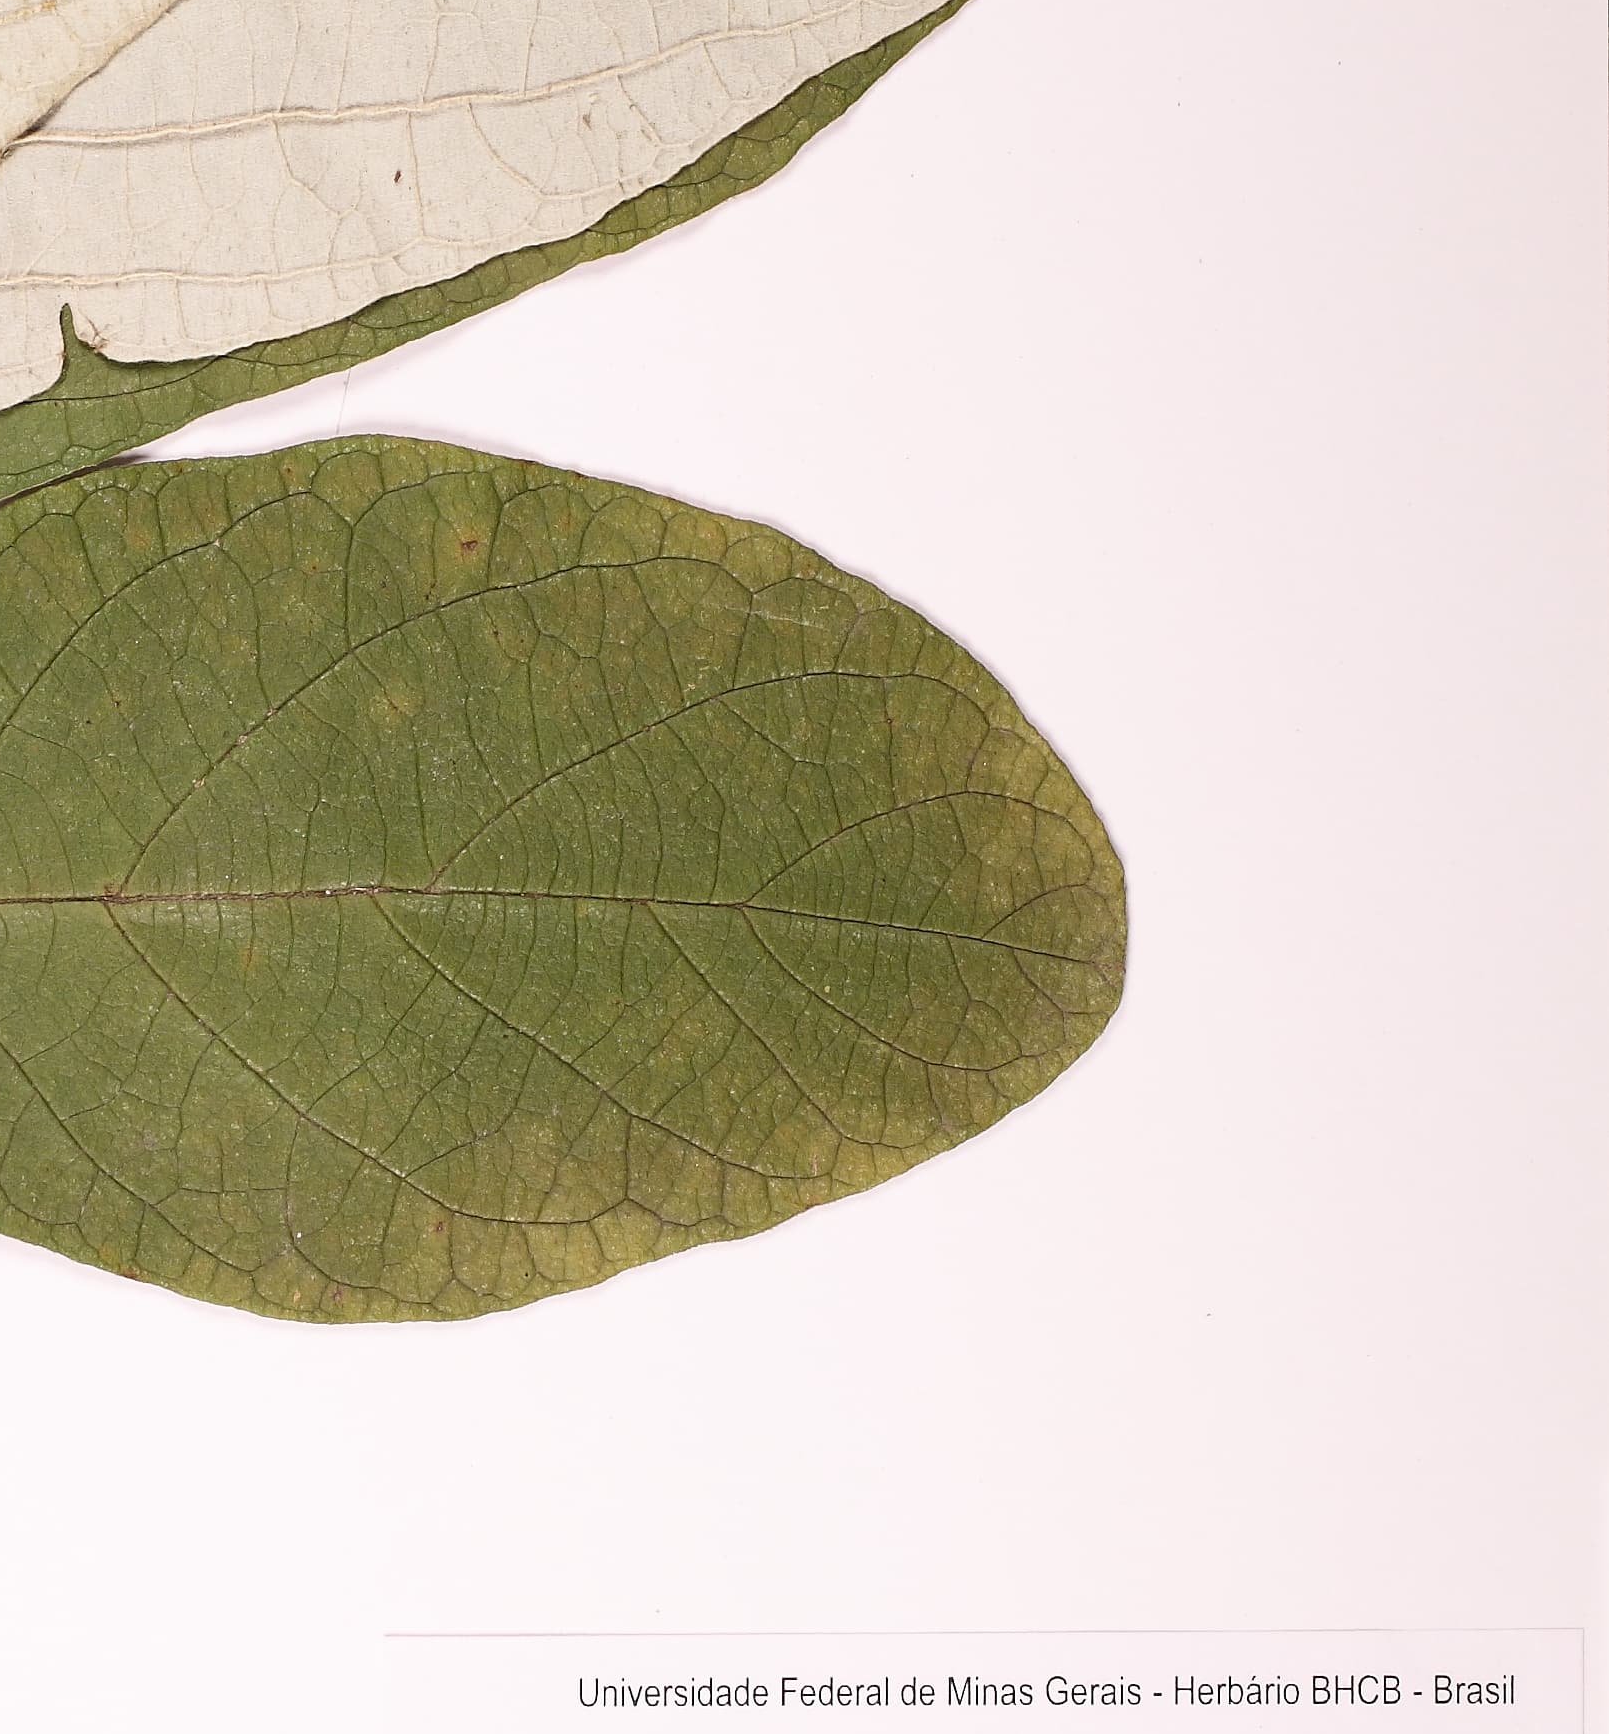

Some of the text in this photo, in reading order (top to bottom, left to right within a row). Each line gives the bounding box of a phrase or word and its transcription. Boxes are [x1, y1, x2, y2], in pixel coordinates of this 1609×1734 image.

[578, 1675, 770, 1709] Universidade
[780, 1674, 890, 1708] Federal
[899, 1674, 937, 1708] de
[946, 1674, 1035, 1708] Minas
[1044, 1674, 1143, 1707] Gerais
[1173, 1673, 1301, 1707] Herbário
[1311, 1673, 1402, 1707] BHCB
[1433, 1673, 1516, 1706] Brasil
